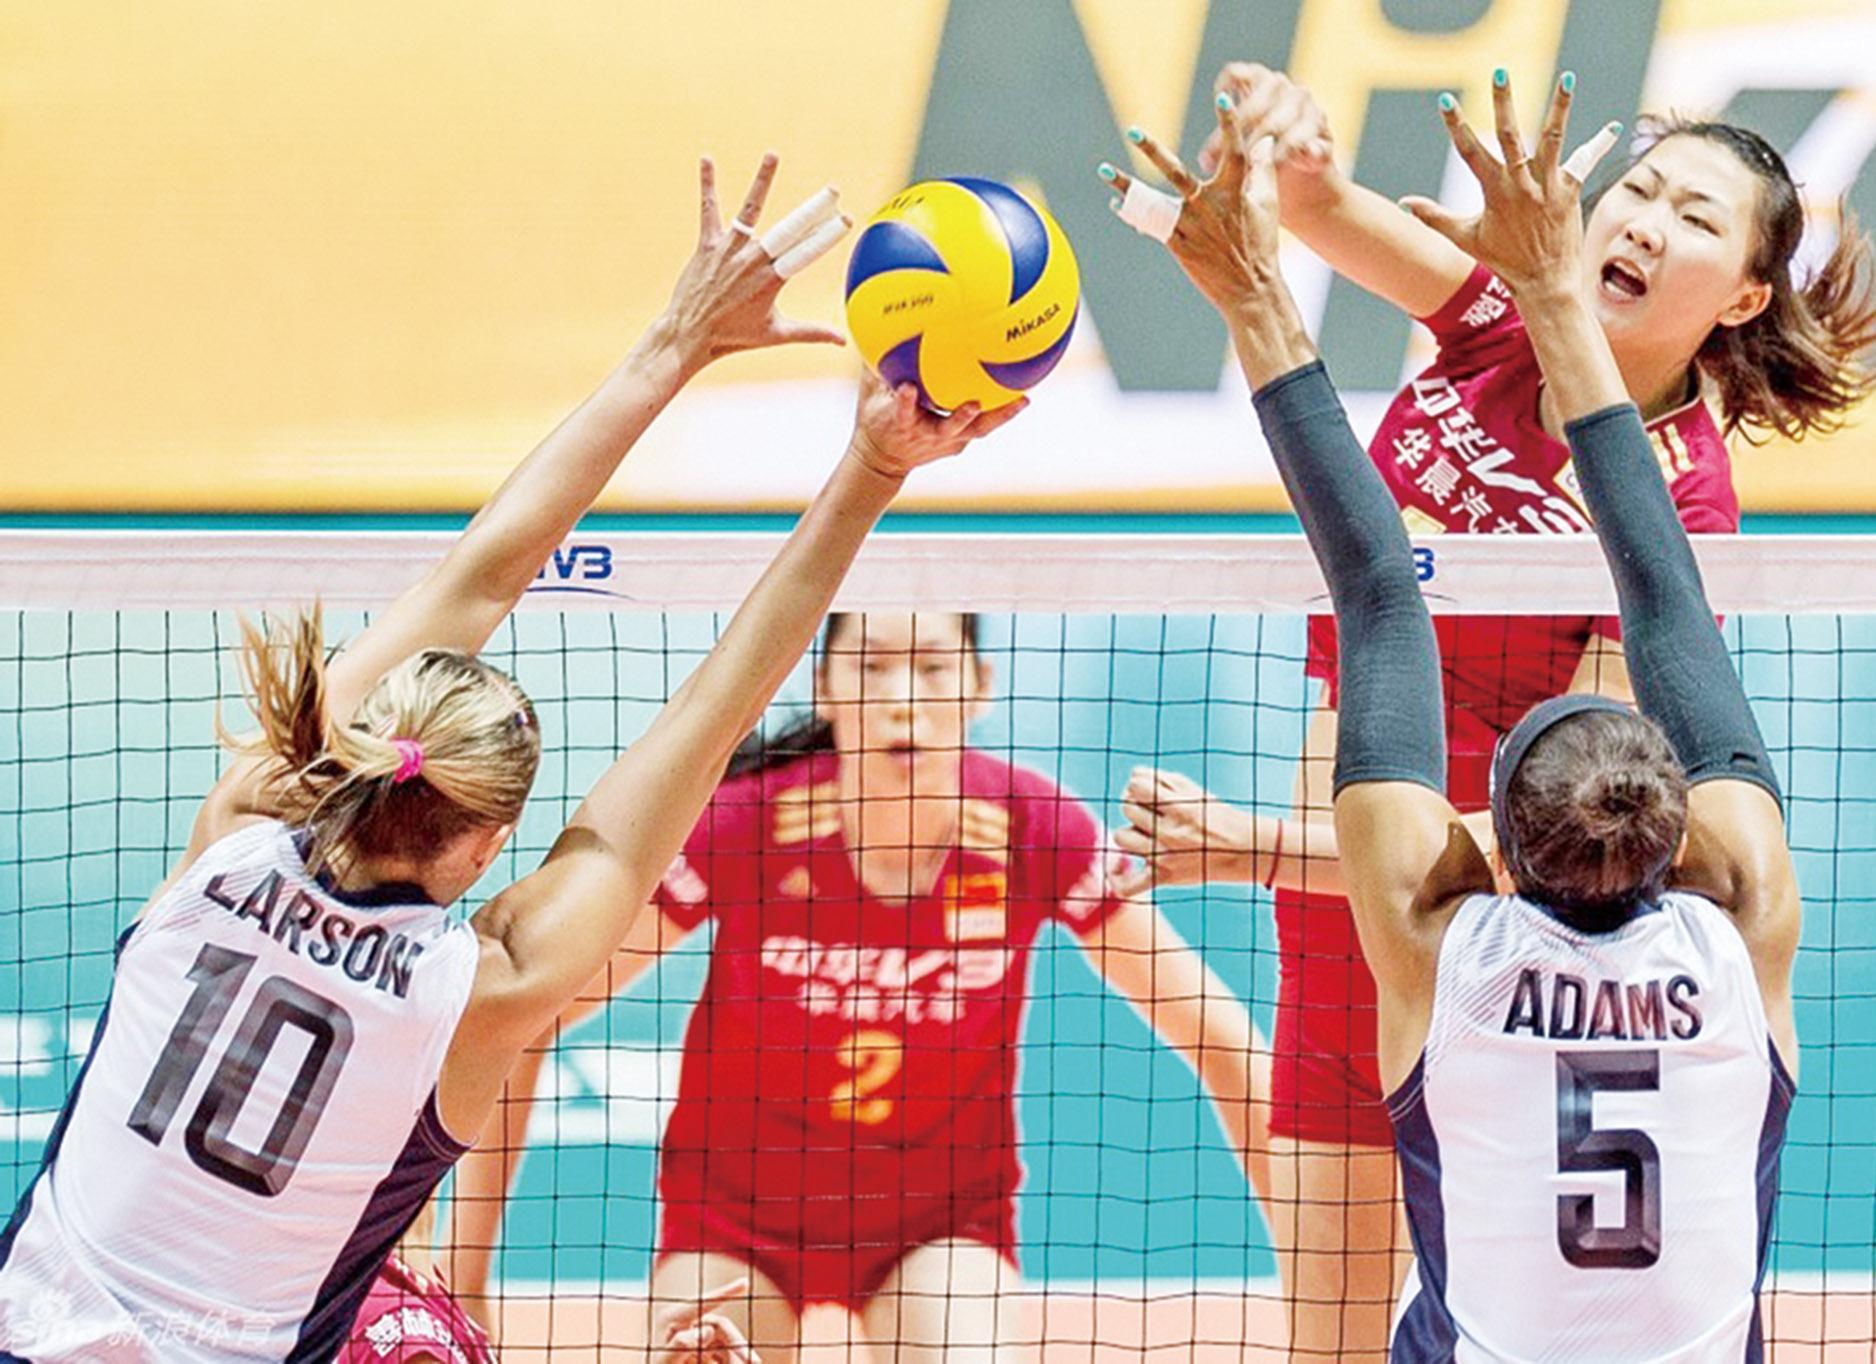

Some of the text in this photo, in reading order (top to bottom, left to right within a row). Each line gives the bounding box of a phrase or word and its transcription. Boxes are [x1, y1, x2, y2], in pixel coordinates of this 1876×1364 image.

[203, 868, 424, 999] LARSON
[126, 942, 355, 1198] 10
[1502, 968, 1703, 1041] ADAMS
[830, 1030, 903, 1125] 2
[1555, 1048, 1661, 1270] 5
